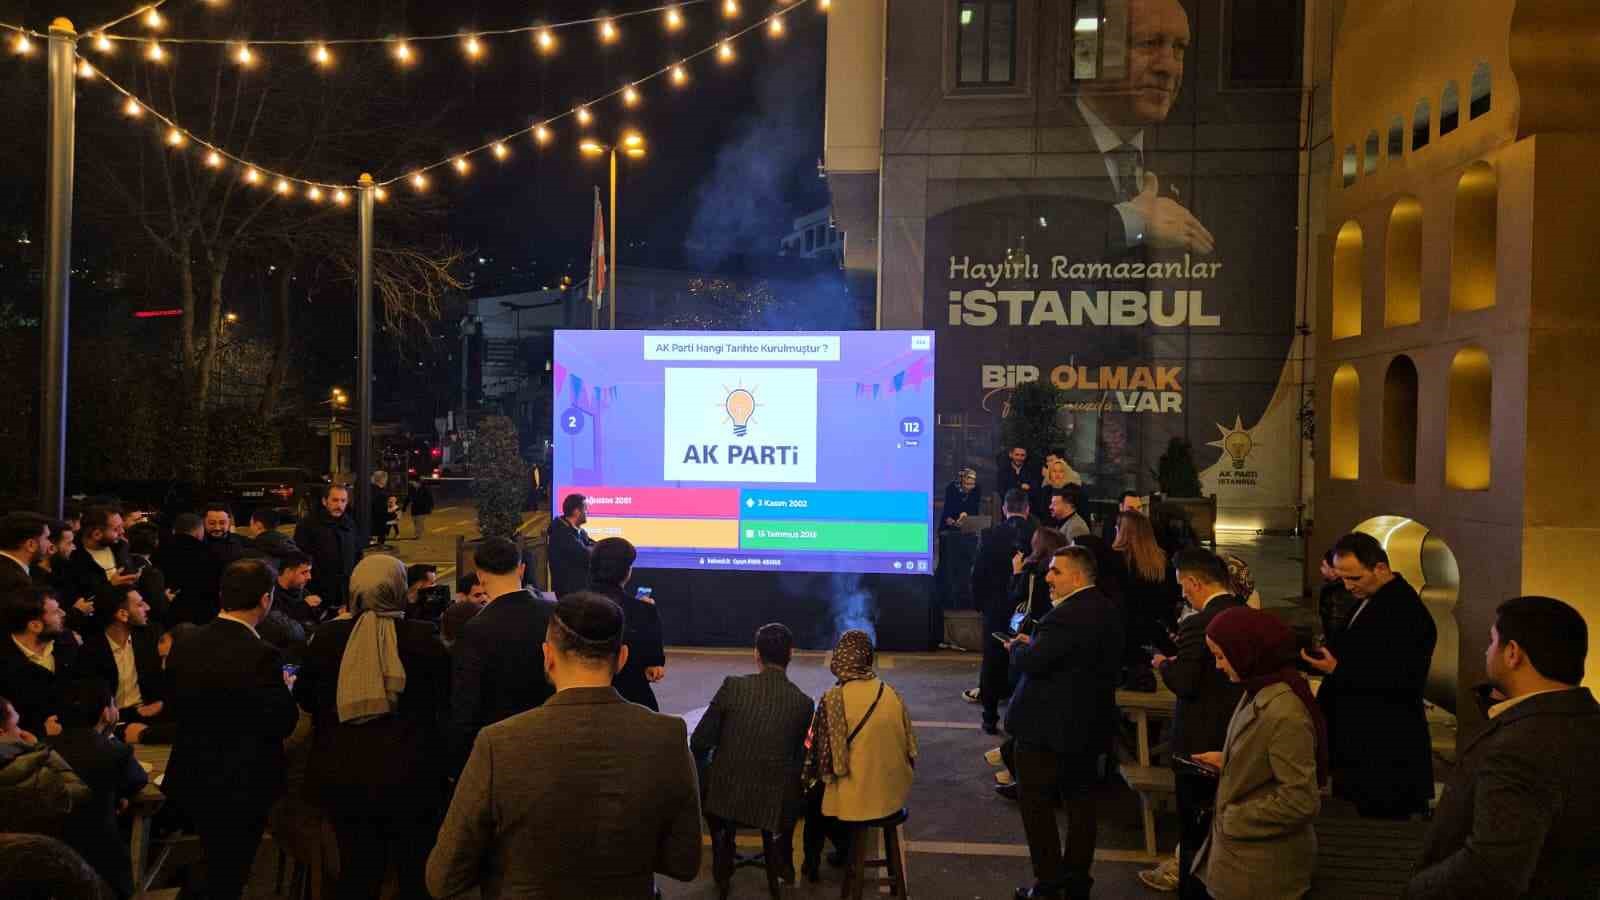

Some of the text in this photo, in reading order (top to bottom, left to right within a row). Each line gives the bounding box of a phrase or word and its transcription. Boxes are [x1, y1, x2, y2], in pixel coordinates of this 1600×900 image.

[1051, 253, 1222, 280] Ramazanlar
[655, 343, 670, 353] AK
[672, 343, 694, 353] Parti
[696, 343, 724, 355] Hangi
[726, 343, 759, 353] Tarihte
[760, 343, 821, 356] Kurulmuştur
[1049, 364, 1185, 391] OLMAK
[1115, 390, 1184, 414] VAR
[568, 415, 577, 428] 2
[904, 422, 920, 433] 112
[682, 444, 719, 465] AK
